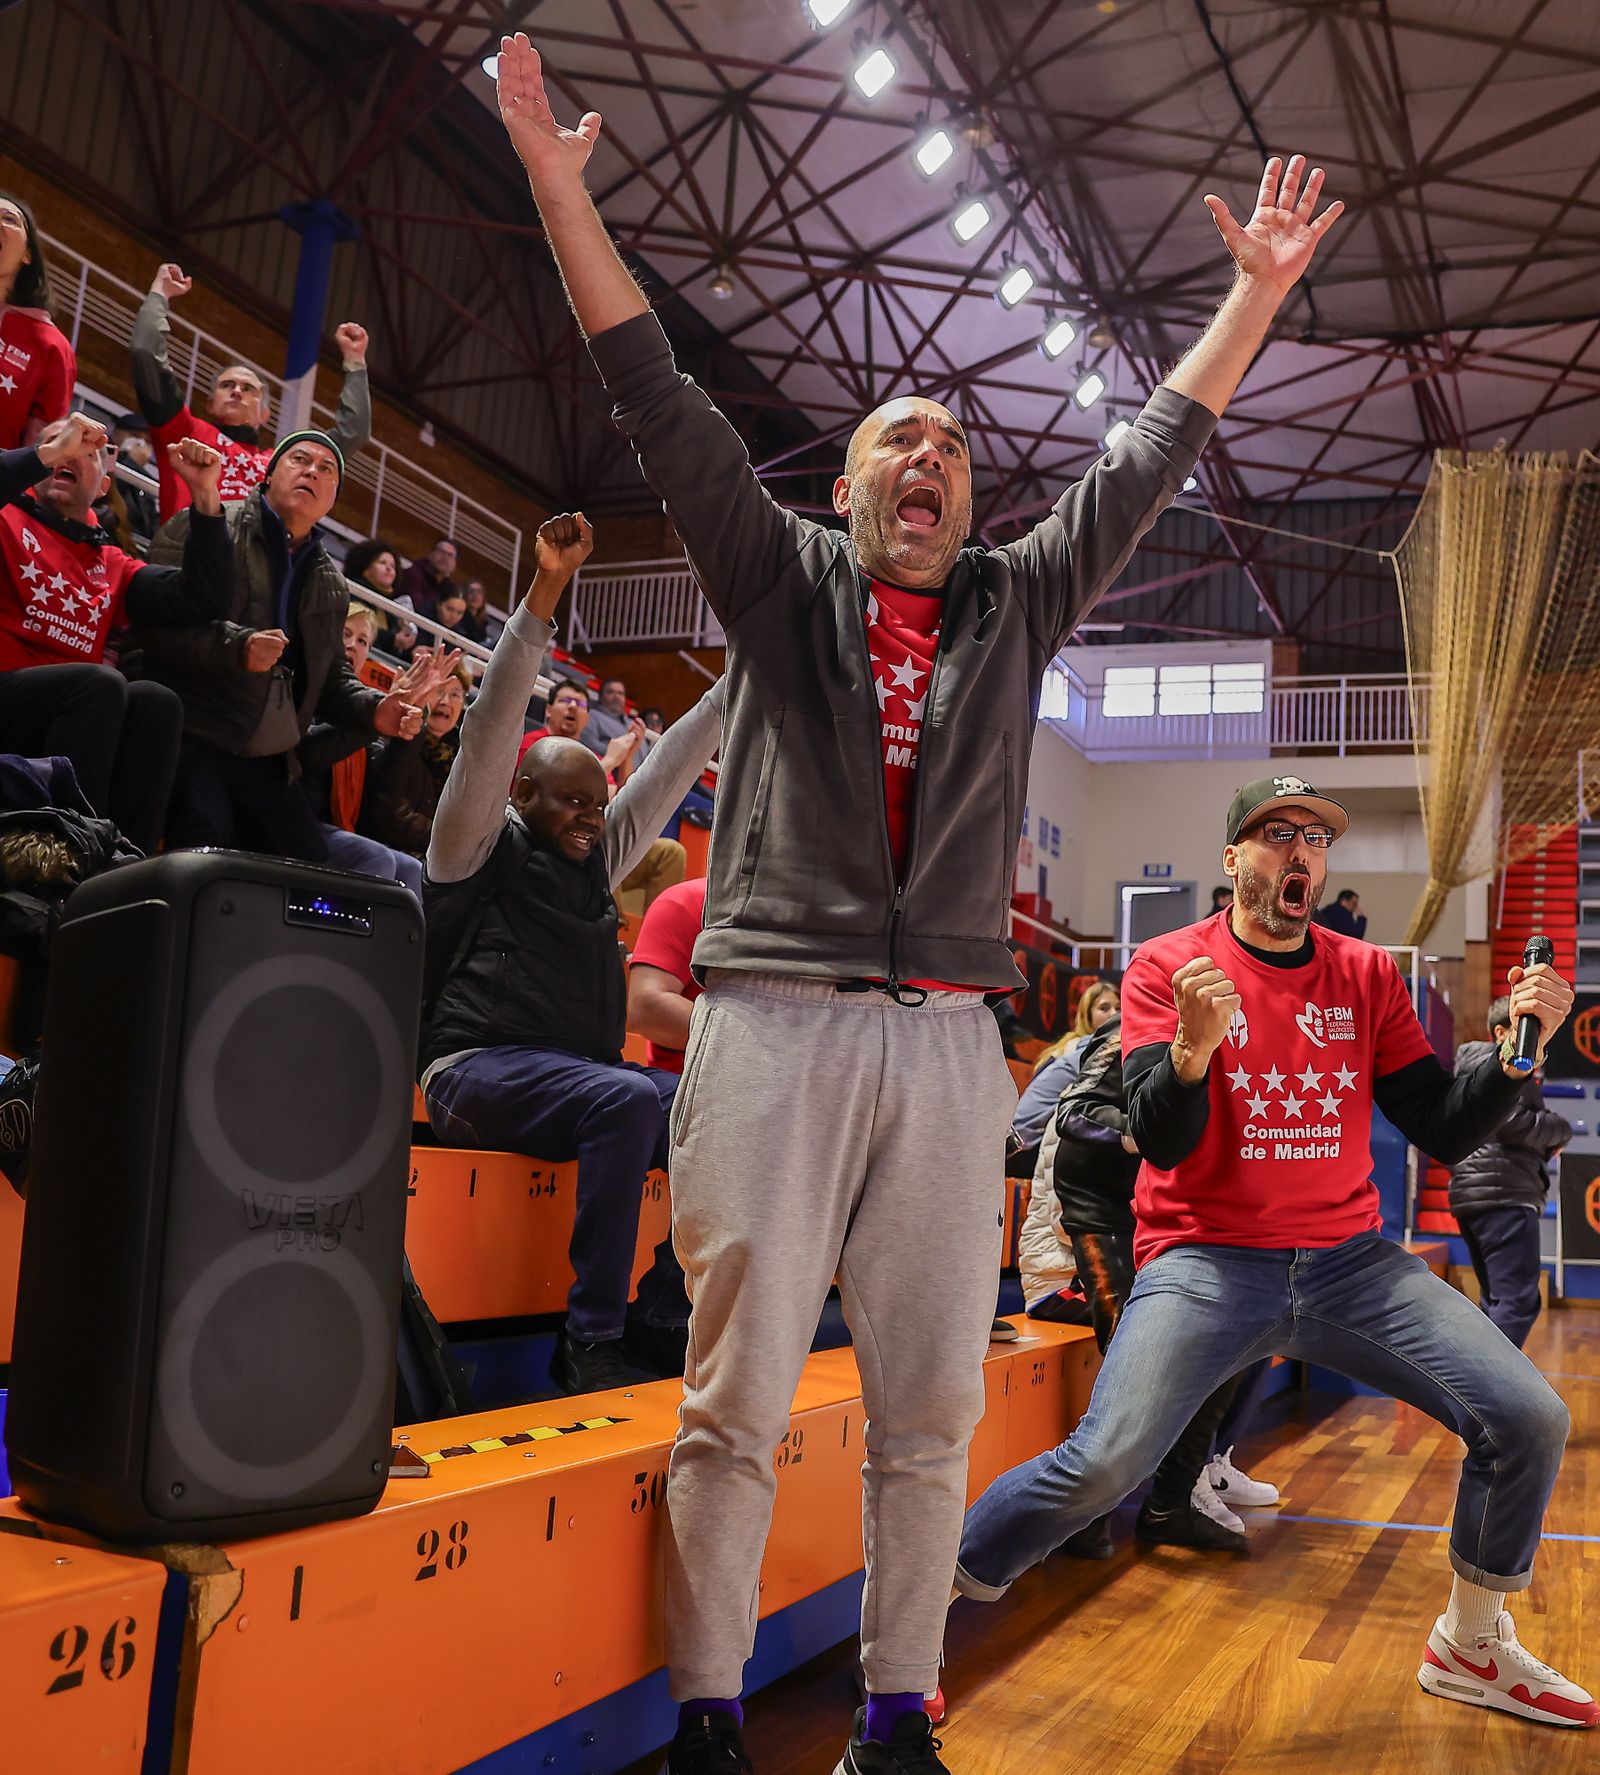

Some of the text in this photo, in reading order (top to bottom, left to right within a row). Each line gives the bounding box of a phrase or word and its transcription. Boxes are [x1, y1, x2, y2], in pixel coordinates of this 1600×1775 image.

[22, 618, 93, 654] de Madrid
[25, 604, 97, 640] Comunidad
[1323, 1006, 1354, 1022] FBM
[1328, 1032, 1356, 1041] MADRID
[1243, 1122, 1342, 1140] Comunidad
[1240, 1142, 1340, 1160] de Madrid
[241, 1188, 364, 1230] VIETA
[275, 1228, 341, 1252] PRO
[415, 1520, 469, 1582] 28
[46, 1615, 137, 1696] 26
